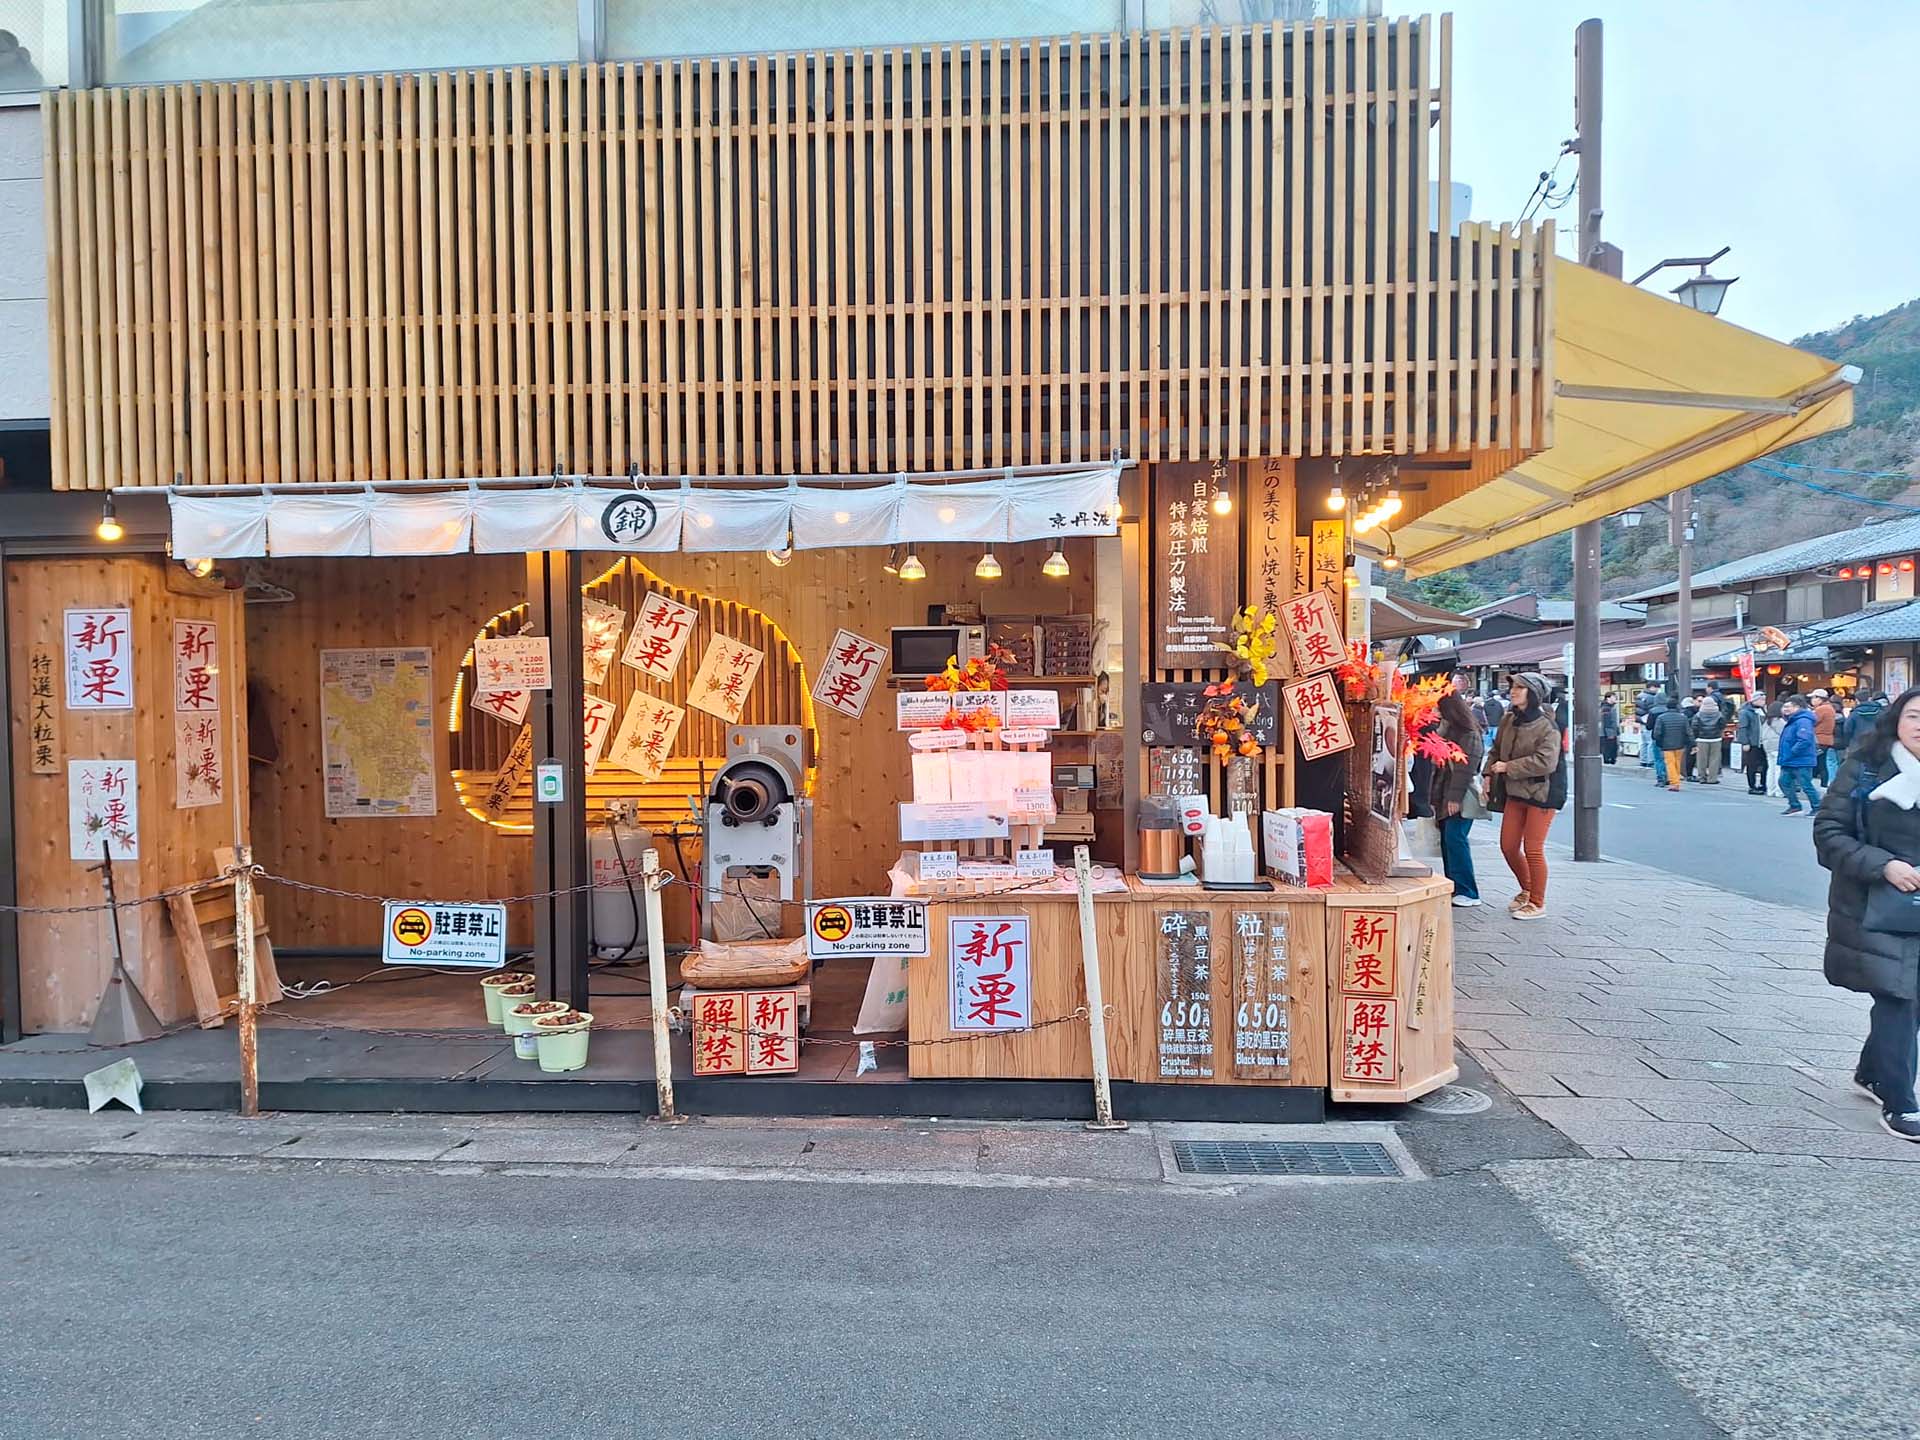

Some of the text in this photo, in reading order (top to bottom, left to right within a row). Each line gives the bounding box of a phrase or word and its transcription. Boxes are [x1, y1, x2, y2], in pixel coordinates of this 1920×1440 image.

[614, 505, 647, 534] 錦
[1048, 511, 1112, 530] 京丹波
[1190, 480, 1209, 554] 自家焙煎
[1168, 501, 1189, 612] 特殊圧力製法
[72, 615, 126, 704] 新栗
[635, 602, 689, 672] 新栗
[1291, 598, 1339, 667] 新栗
[179, 625, 215, 709] 新栗
[720, 648, 756, 698] 新栗
[824, 639, 879, 709] 新栗
[31, 655, 55, 767] 特選大粒栗
[643, 706, 676, 754] 新栗
[1295, 681, 1340, 751] 解禁
[197, 718, 218, 777] 新栗
[100, 767, 129, 830] 新栗
[434, 911, 499, 937] 駐車禁止
[832, 941, 910, 951] No-parking zone
[855, 905, 923, 929] 駐車禁止
[1236, 913, 1265, 937] 粒
[409, 947, 486, 959] No-parking zone
[956, 922, 1024, 1026] 新栗
[1193, 925, 1210, 981] 黒豆茶
[1271, 926, 1288, 982] 黒豆茶
[1351, 915, 1389, 990] 新栗
[703, 997, 737, 1070] 解禁
[754, 996, 790, 1067] 新栗
[1236, 1052, 1256, 1065] Black
[1257, 1052, 1275, 1065] bean
[1352, 1000, 1390, 1077] 解禁
[1161, 1065, 1180, 1076] Black
[1181, 1066, 1199, 1076] bean
